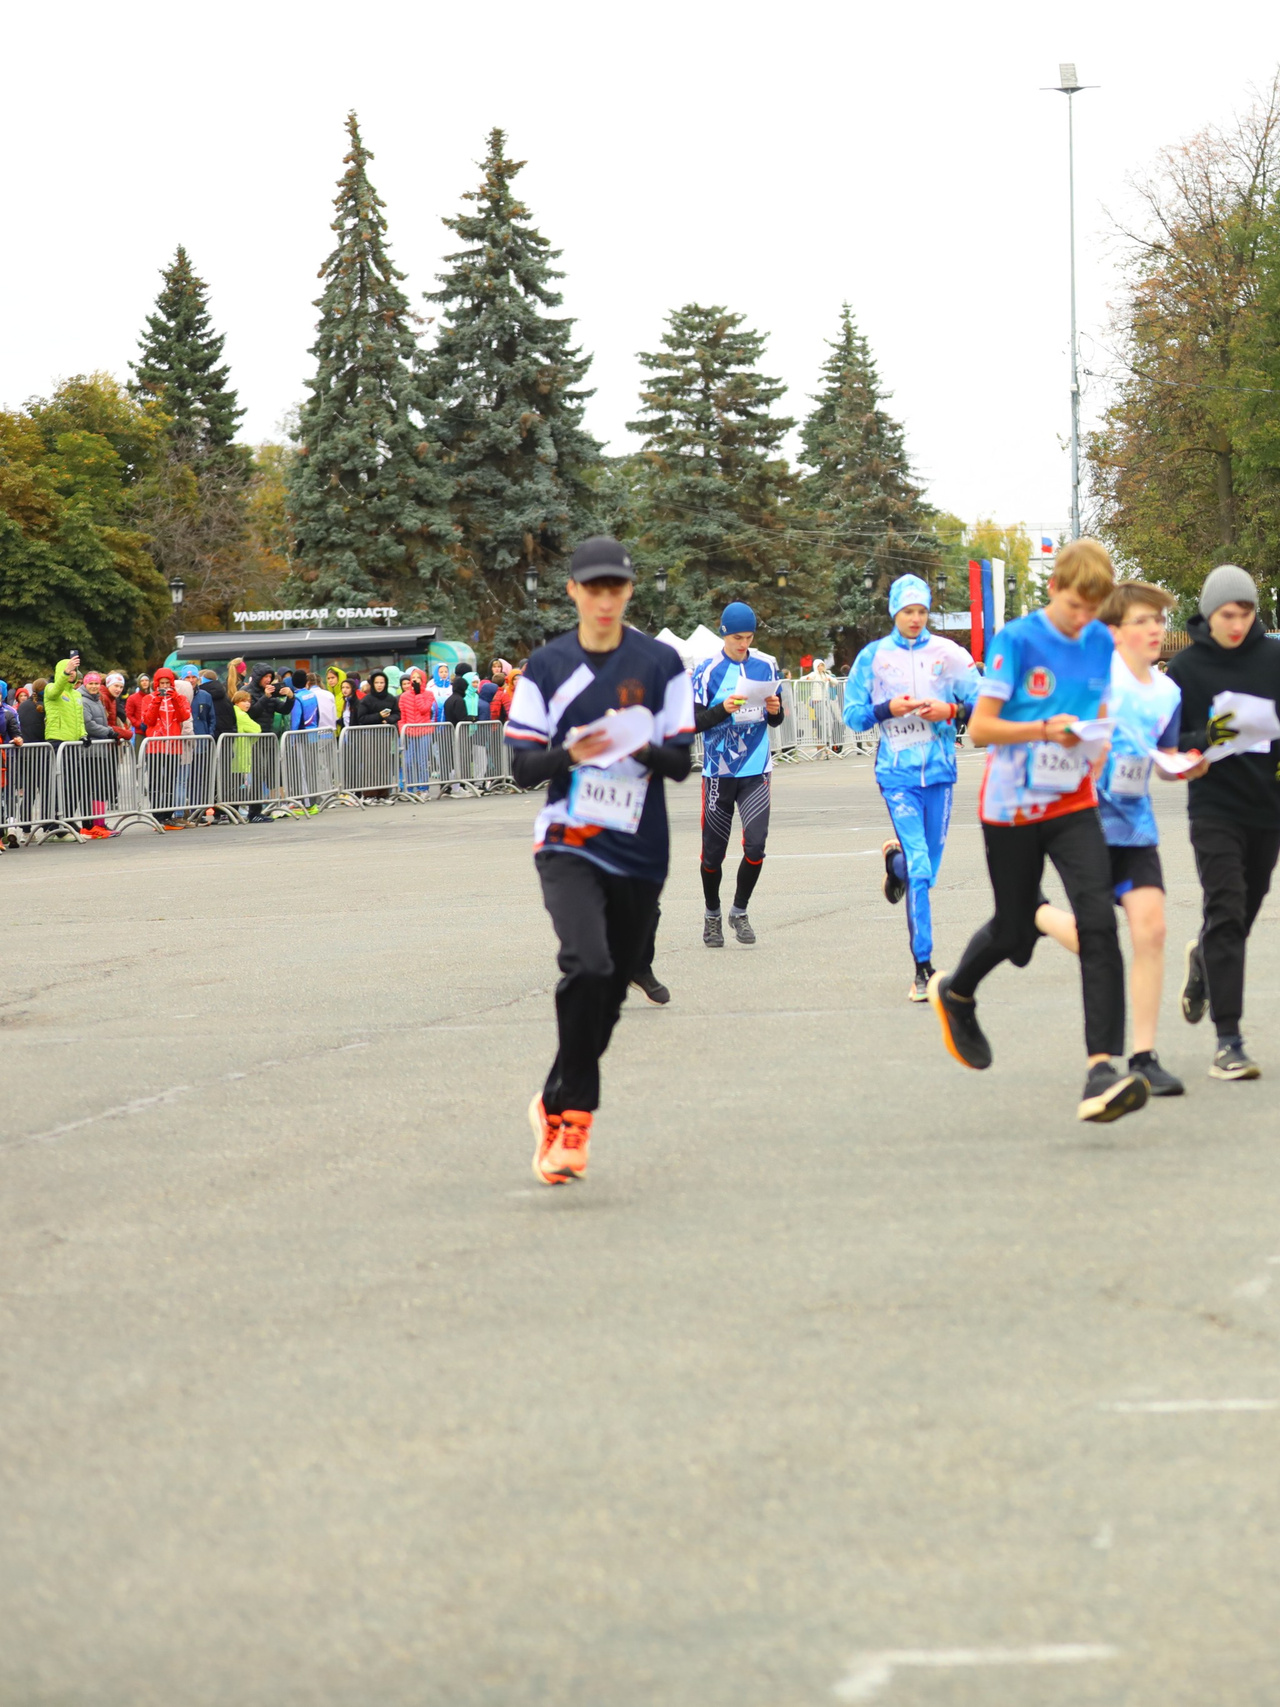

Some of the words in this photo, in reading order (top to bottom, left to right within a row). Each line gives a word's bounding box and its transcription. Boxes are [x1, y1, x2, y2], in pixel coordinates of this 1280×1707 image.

[233, 609, 329, 622] УЛЬЯНОВСКАЯ
[337, 606, 398, 618] ОБЛАСТЬ
[581, 783, 632, 807] 303.1
